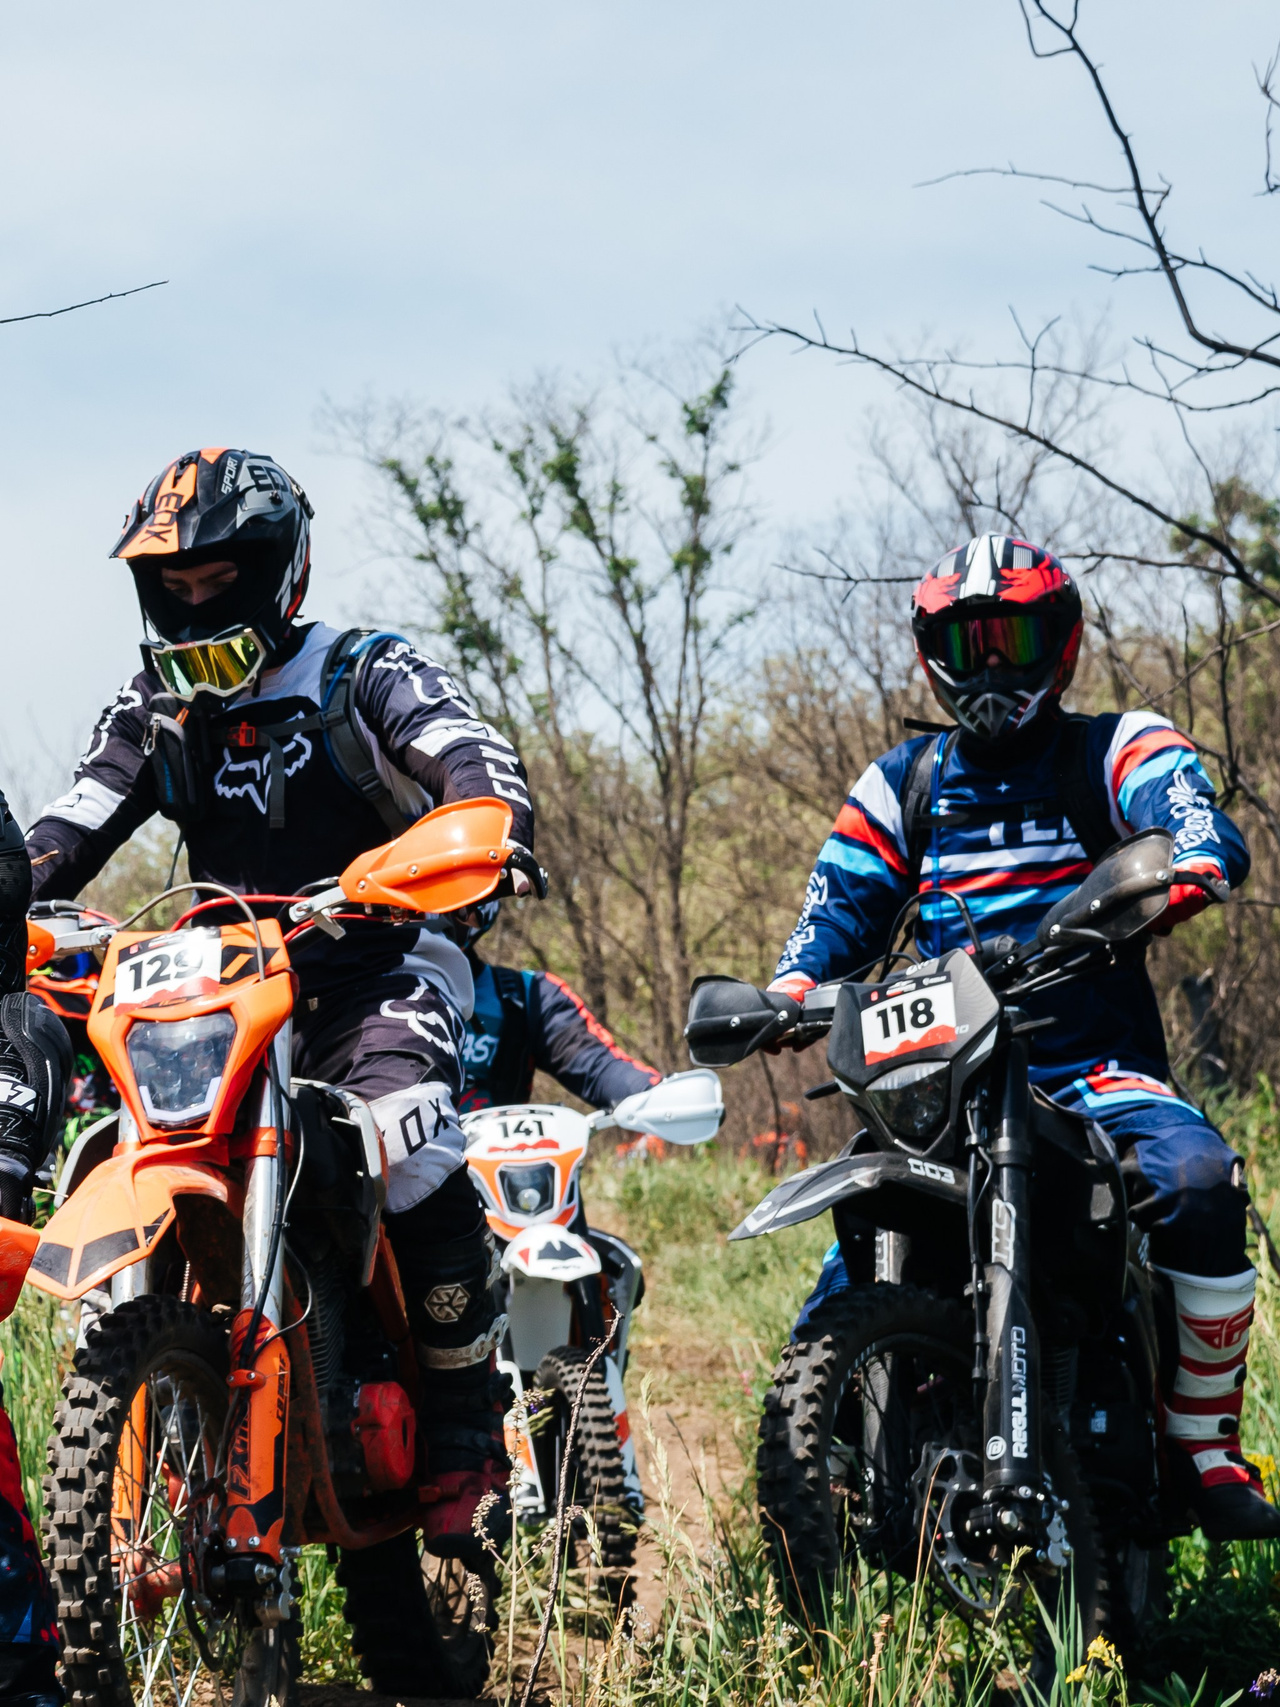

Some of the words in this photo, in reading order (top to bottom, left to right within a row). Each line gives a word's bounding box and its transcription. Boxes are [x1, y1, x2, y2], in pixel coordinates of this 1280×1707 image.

[221, 456, 238, 494] SPORT
[129, 948, 204, 992] 129
[876, 997, 936, 1040] 118
[497, 1119, 545, 1139] 141
[1010, 1325, 1029, 1460] REGULMOTO
